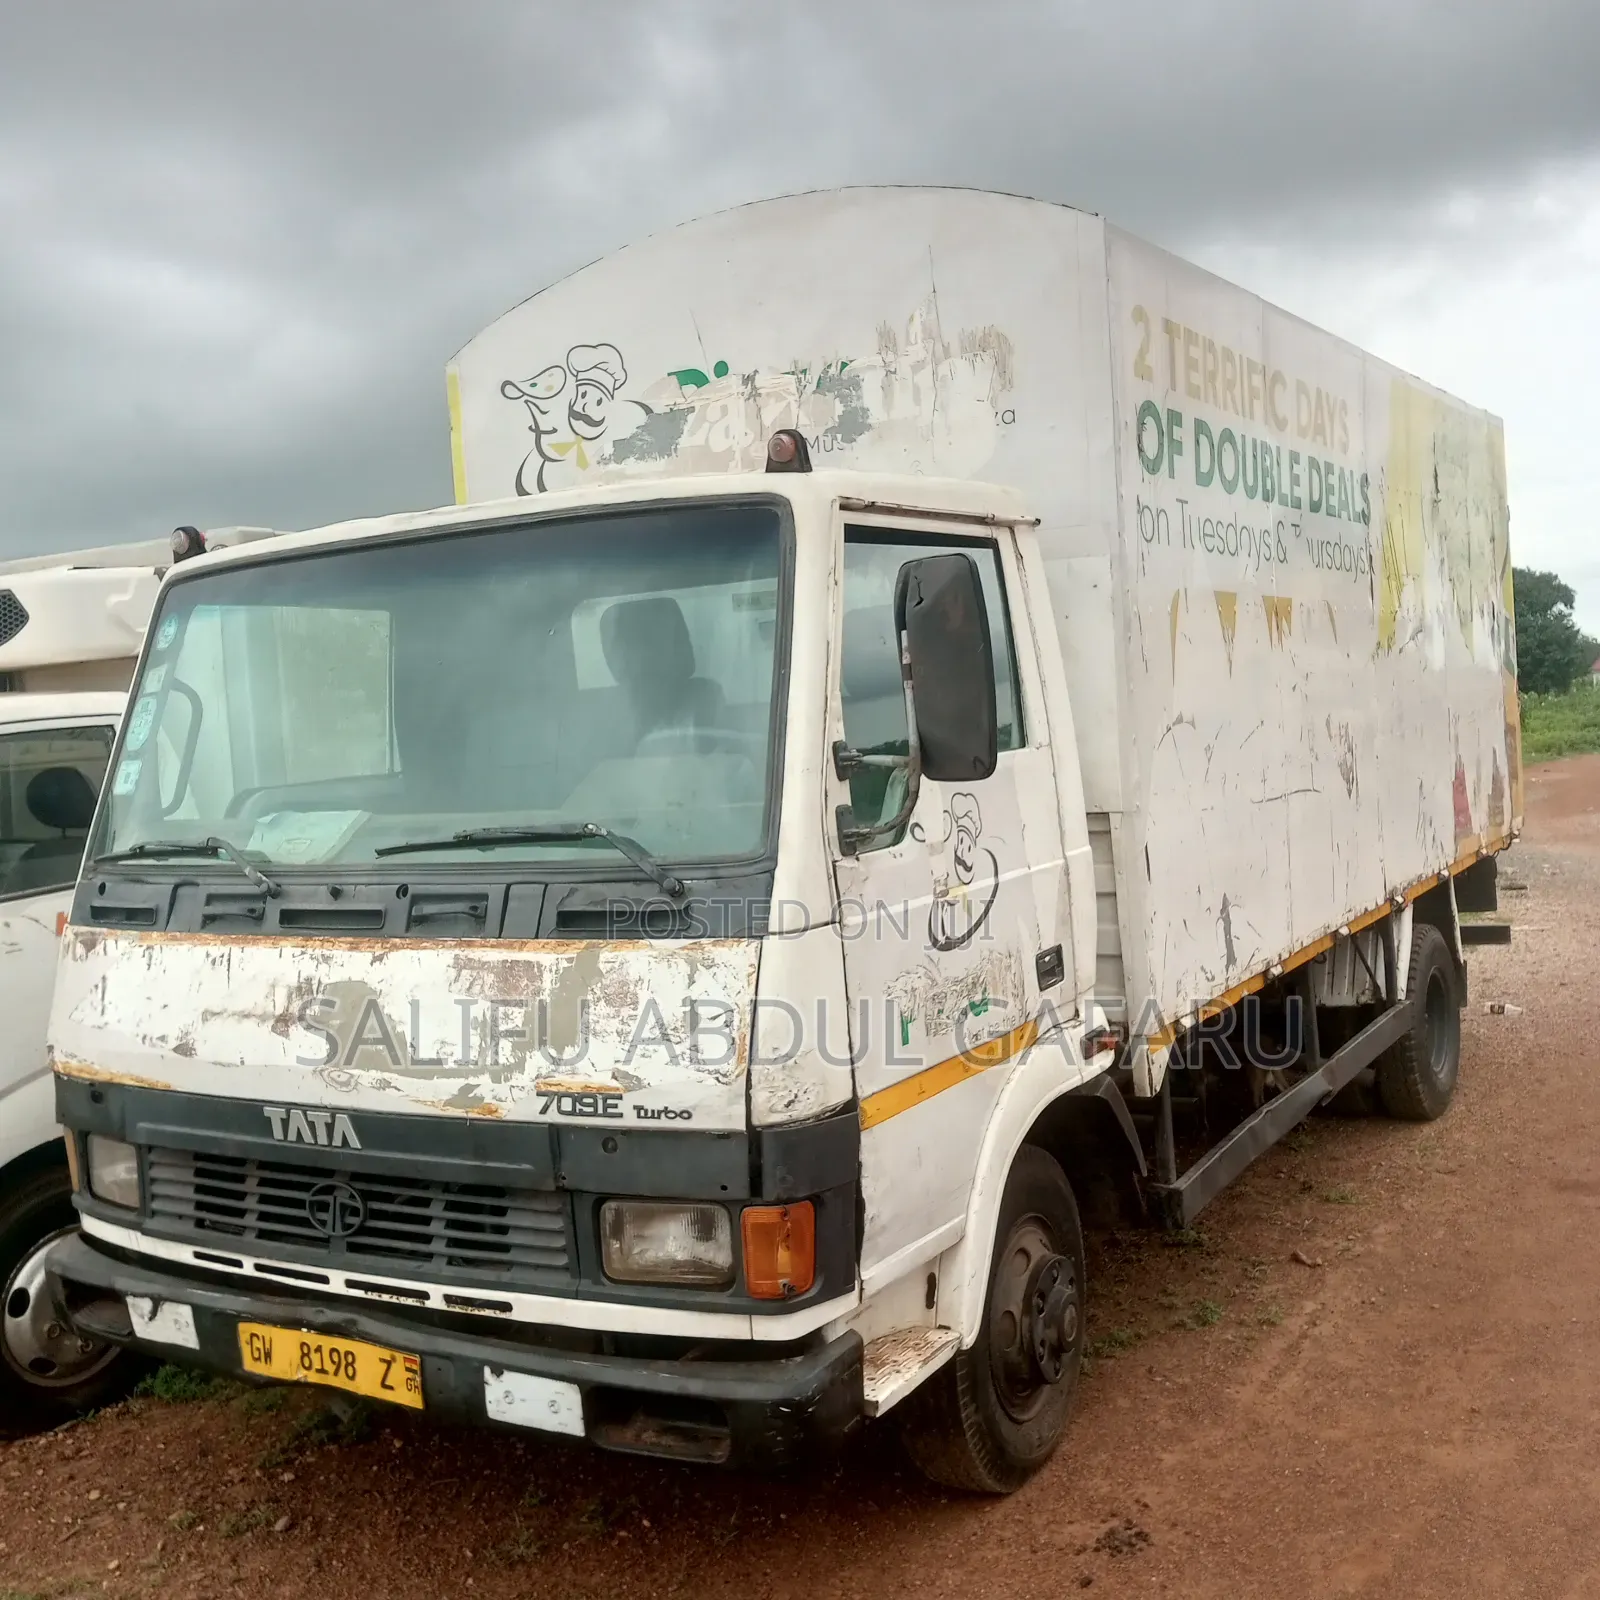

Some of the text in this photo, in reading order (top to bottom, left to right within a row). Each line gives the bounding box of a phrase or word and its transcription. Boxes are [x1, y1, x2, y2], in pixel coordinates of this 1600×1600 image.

[1131, 304, 1350, 455] 2 TERRIFIC DAYS
[1136, 399, 1371, 526] OF DOUBLE DEALS
[1139, 504, 1170, 547] on
[1276, 519, 1289, 565] &
[263, 1106, 362, 1151] TATA
[536, 1091, 693, 1120] 709E Turbo
[250, 1332, 396, 1391] GW 8198 Z
